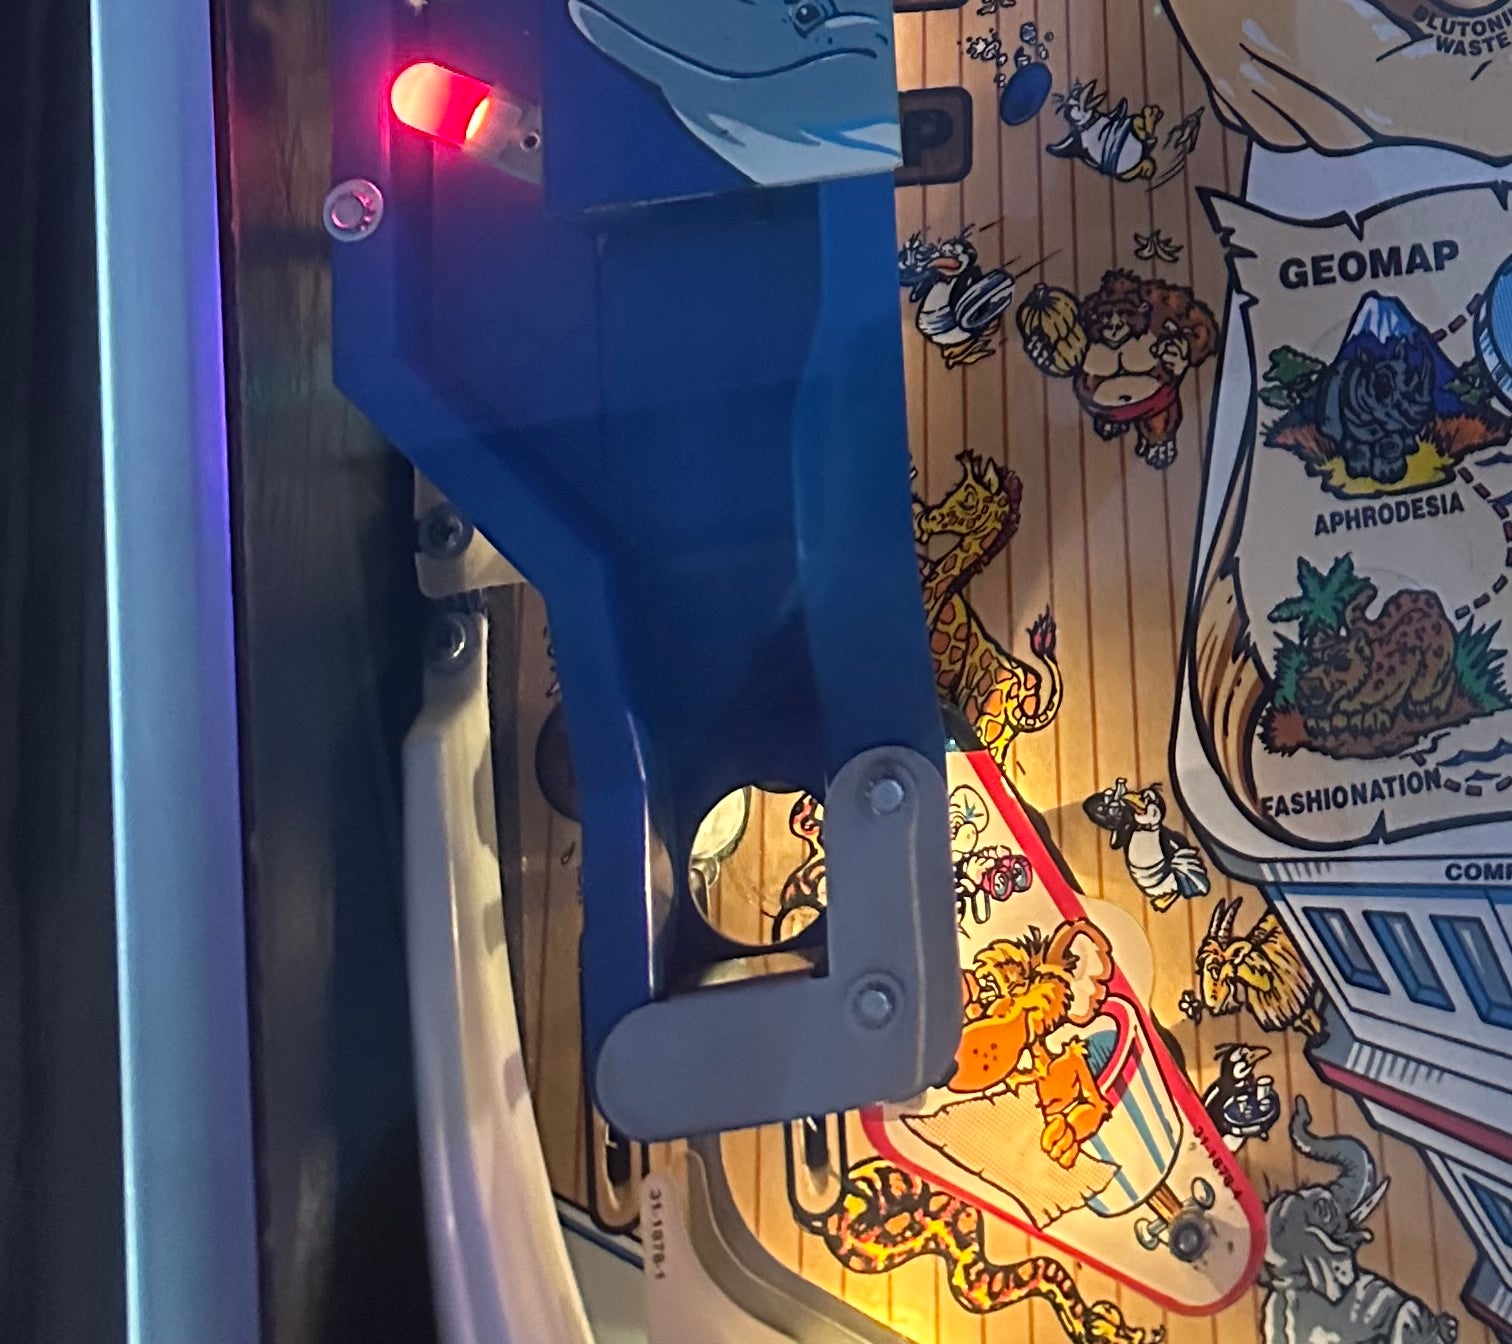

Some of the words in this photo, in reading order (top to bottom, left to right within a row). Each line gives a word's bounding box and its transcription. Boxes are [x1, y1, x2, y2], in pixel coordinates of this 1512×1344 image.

[1435, 30, 1512, 57] WASTE
[901, 112, 954, 167] P
[1279, 239, 1460, 291] GEOMAP
[1314, 492, 1465, 537] APHRODESIA
[1261, 768, 1441, 819] FASHIONATION
